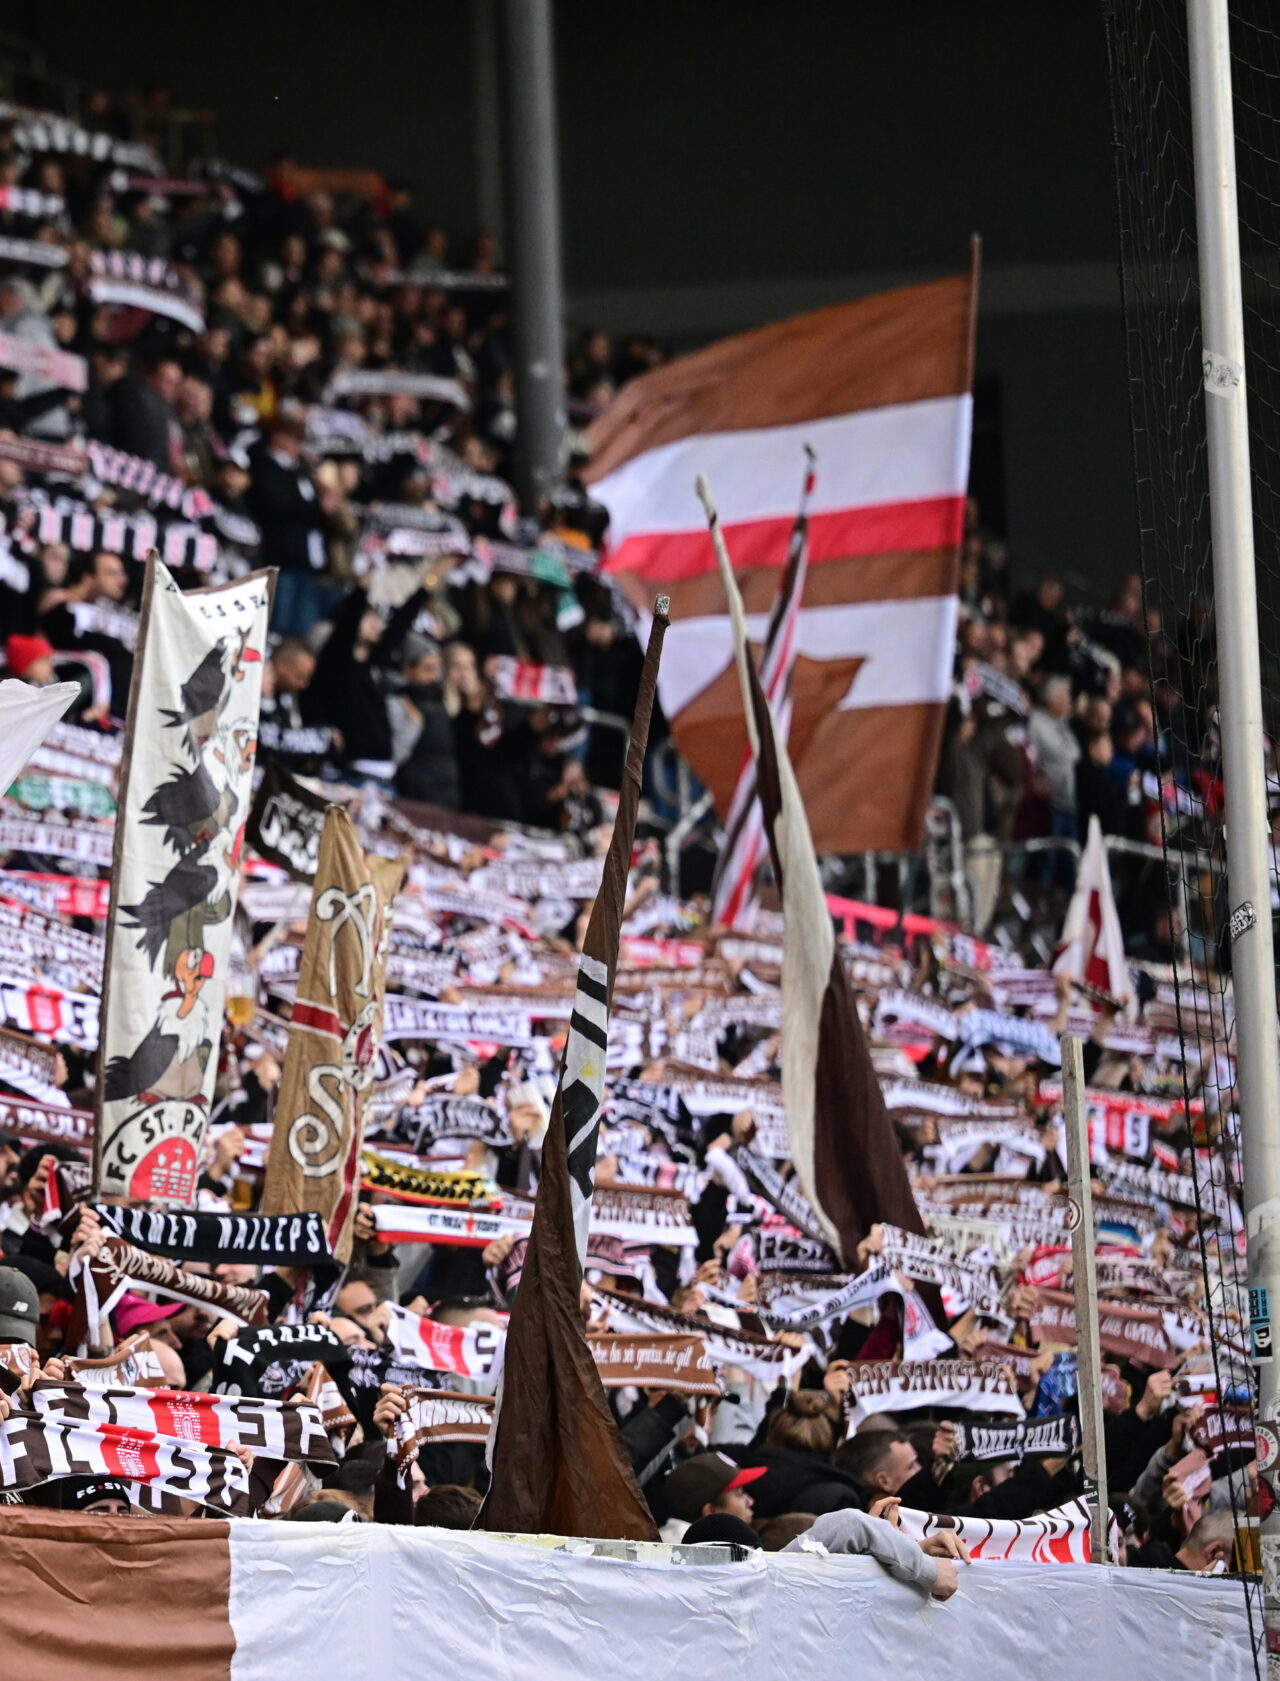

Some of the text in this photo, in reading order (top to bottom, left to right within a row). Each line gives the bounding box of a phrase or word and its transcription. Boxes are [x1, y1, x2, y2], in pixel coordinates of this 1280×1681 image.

[16, 1107, 88, 1142] PAULI
[106, 1142, 138, 1182] FC
[140, 1108, 173, 1145] ST.
[971, 1418, 1070, 1452] SANKT PAULI
[76, 1486, 97, 1499] FC
